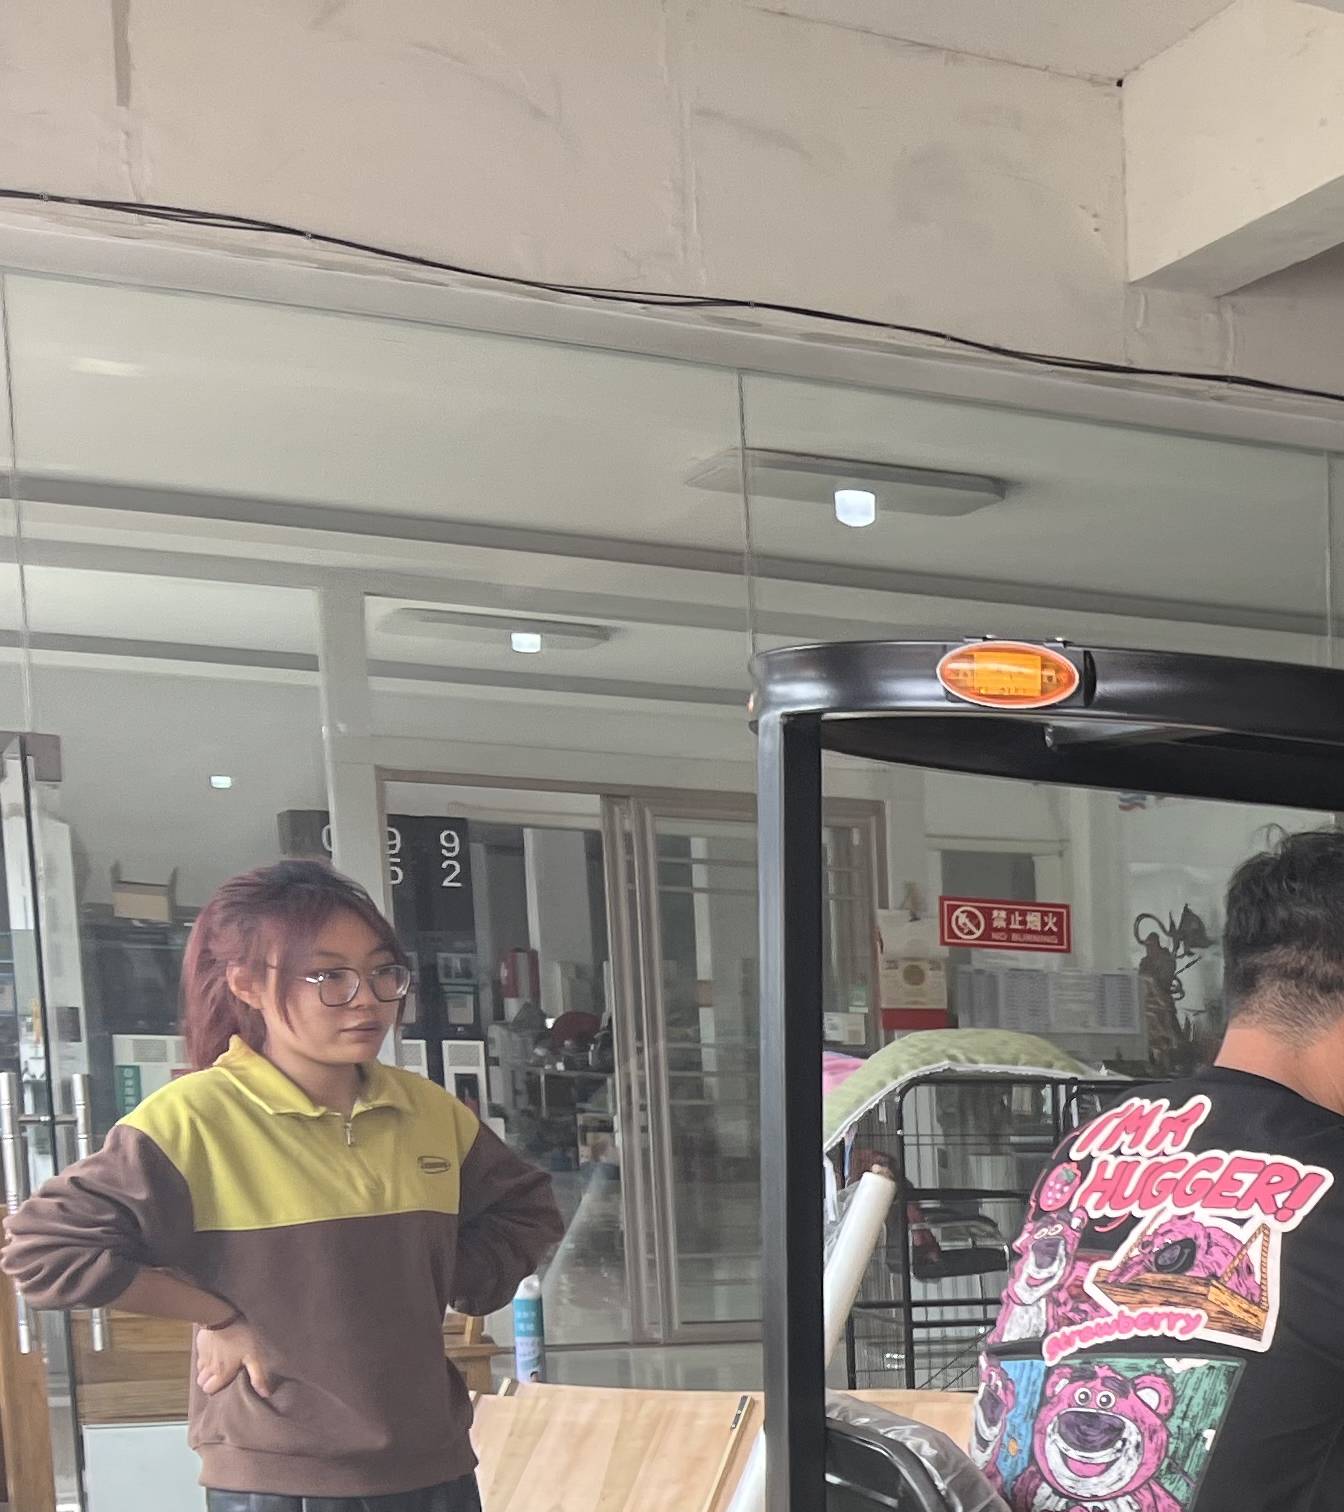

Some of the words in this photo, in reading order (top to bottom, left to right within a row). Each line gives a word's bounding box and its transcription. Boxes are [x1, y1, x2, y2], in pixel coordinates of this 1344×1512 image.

[992, 909, 1058, 932] 禁止烟火
[1146, 1101, 1206, 1152] A
[1078, 1156, 1326, 1223] HUGGER!
